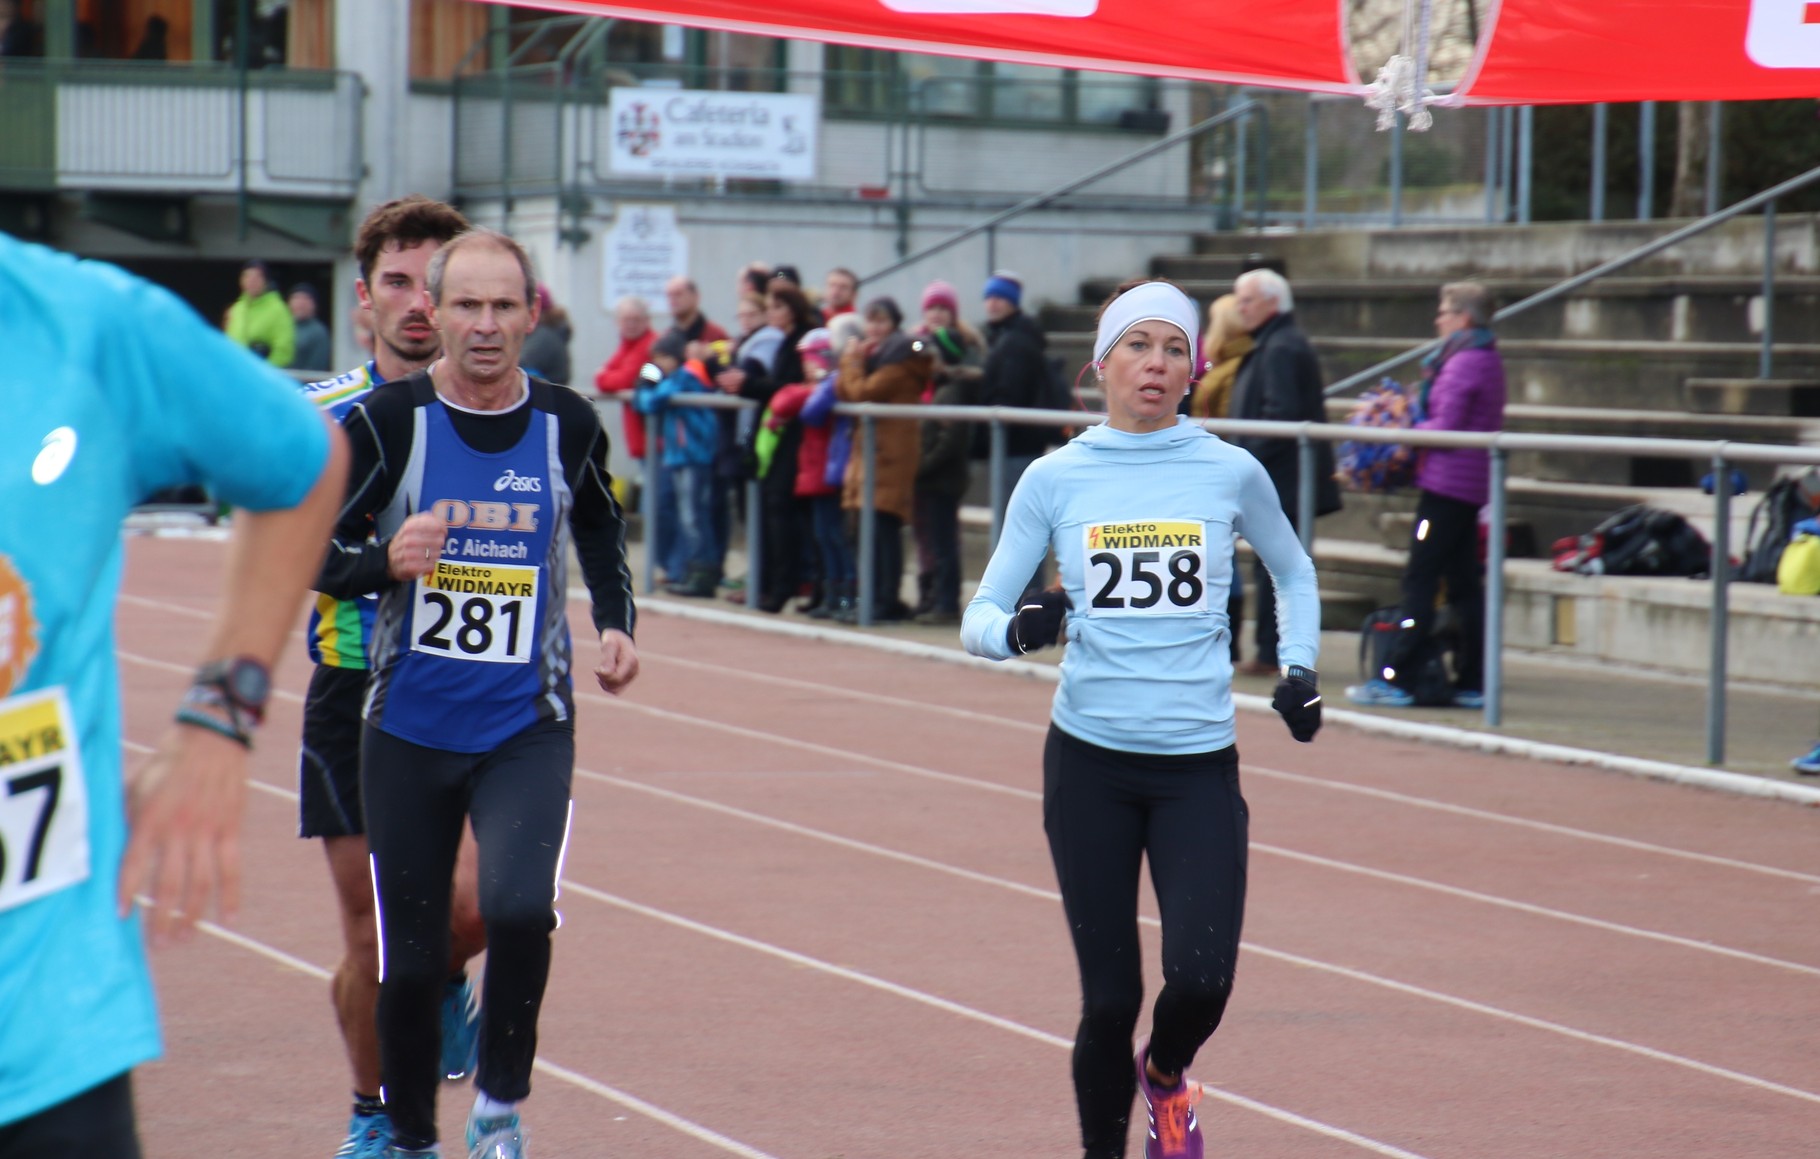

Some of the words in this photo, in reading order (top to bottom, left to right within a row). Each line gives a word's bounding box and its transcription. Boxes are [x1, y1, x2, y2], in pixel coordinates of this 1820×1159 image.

[665, 96, 771, 126] Cafeteria
[431, 499, 540, 533] OBI
[1102, 524, 1157, 534] Elektro
[462, 538, 528, 559] Aichach
[1103, 534, 1202, 549] WIDMAYR
[437, 562, 492, 578] Elektro
[1090, 549, 1204, 609] 258
[437, 576, 533, 597] WIDMAYR
[418, 591, 522, 656] 281
